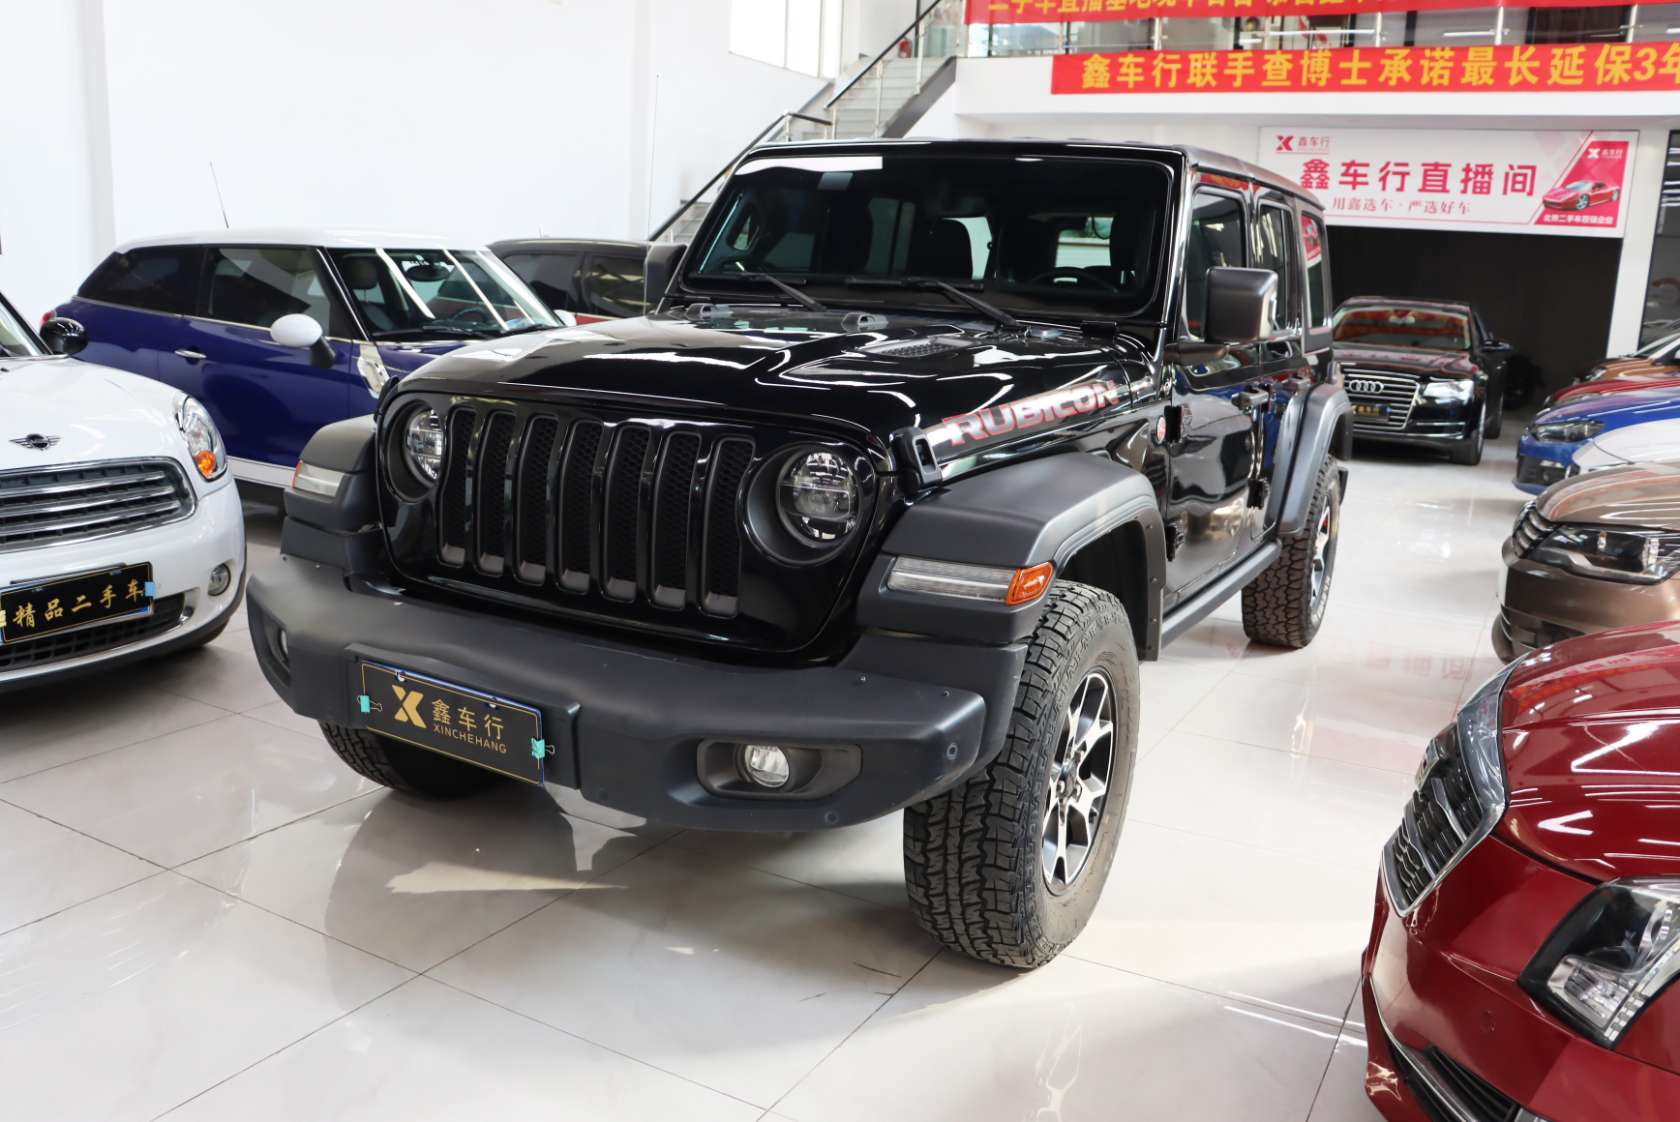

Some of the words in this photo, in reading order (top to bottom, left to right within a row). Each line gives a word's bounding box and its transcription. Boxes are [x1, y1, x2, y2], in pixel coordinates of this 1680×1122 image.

[1081, 42, 1680, 89] 鑫车行联手查博士承诺最长延保3年
[1300, 158, 1538, 197] 鑫车行直播间
[942, 380, 1119, 446] RUBICON
[12, 579, 145, 628] 精品二手车
[431, 699, 504, 740] 鑫车行
[432, 724, 507, 754] XINCHEHANG
